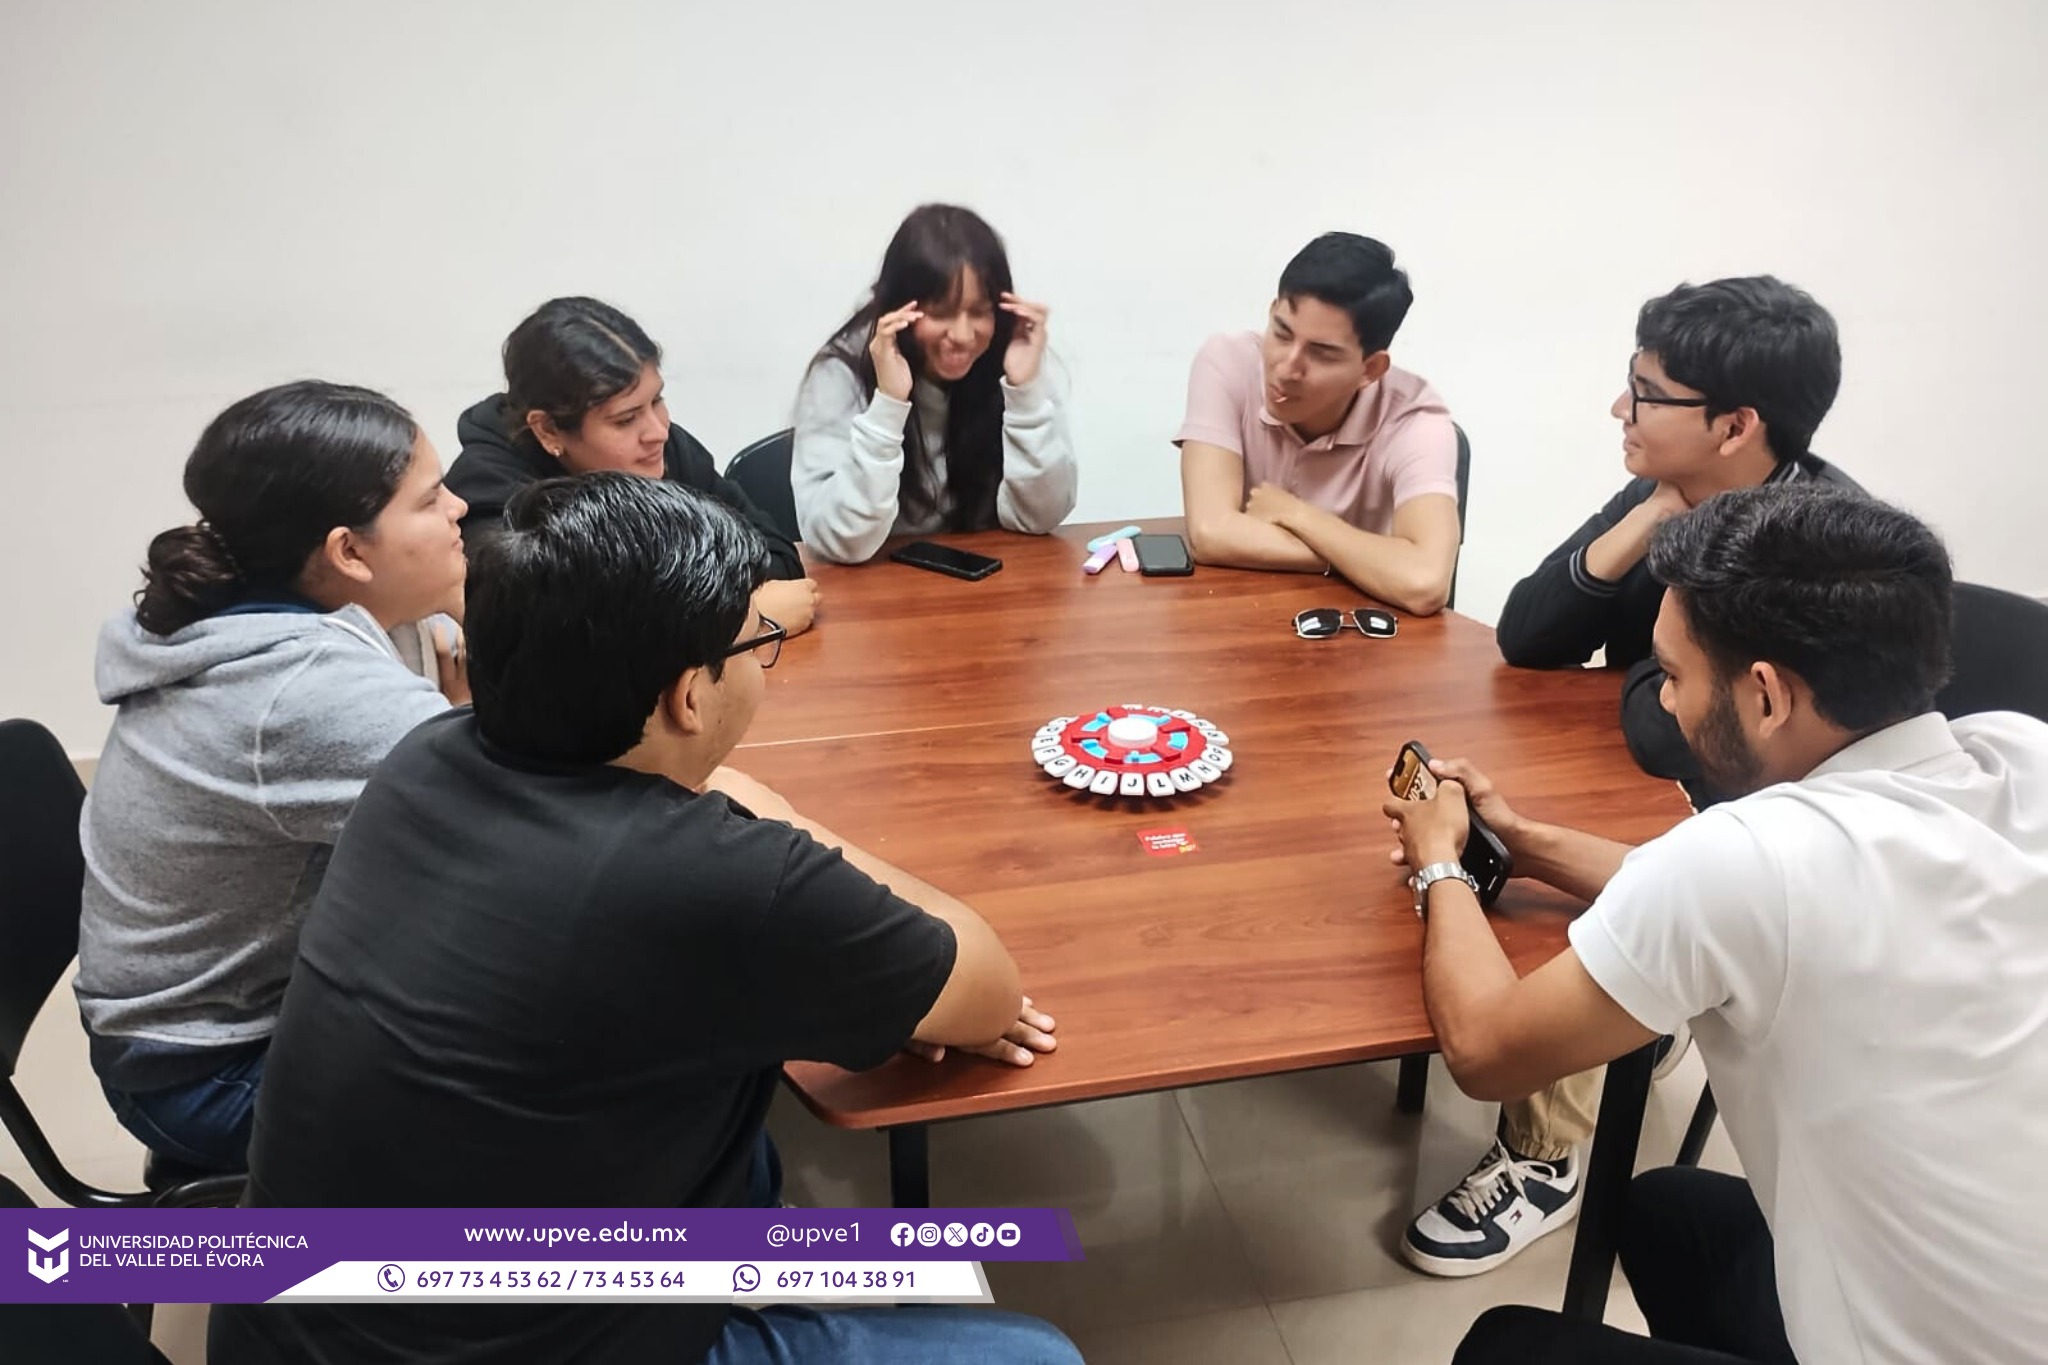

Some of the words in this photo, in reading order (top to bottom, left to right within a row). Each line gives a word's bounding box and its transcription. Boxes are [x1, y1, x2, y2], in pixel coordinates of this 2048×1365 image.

[1074, 769, 1088, 778] H
[1179, 772, 1194, 783] M
[1127, 778, 1138, 787] J
[1157, 778, 1166, 788] L
